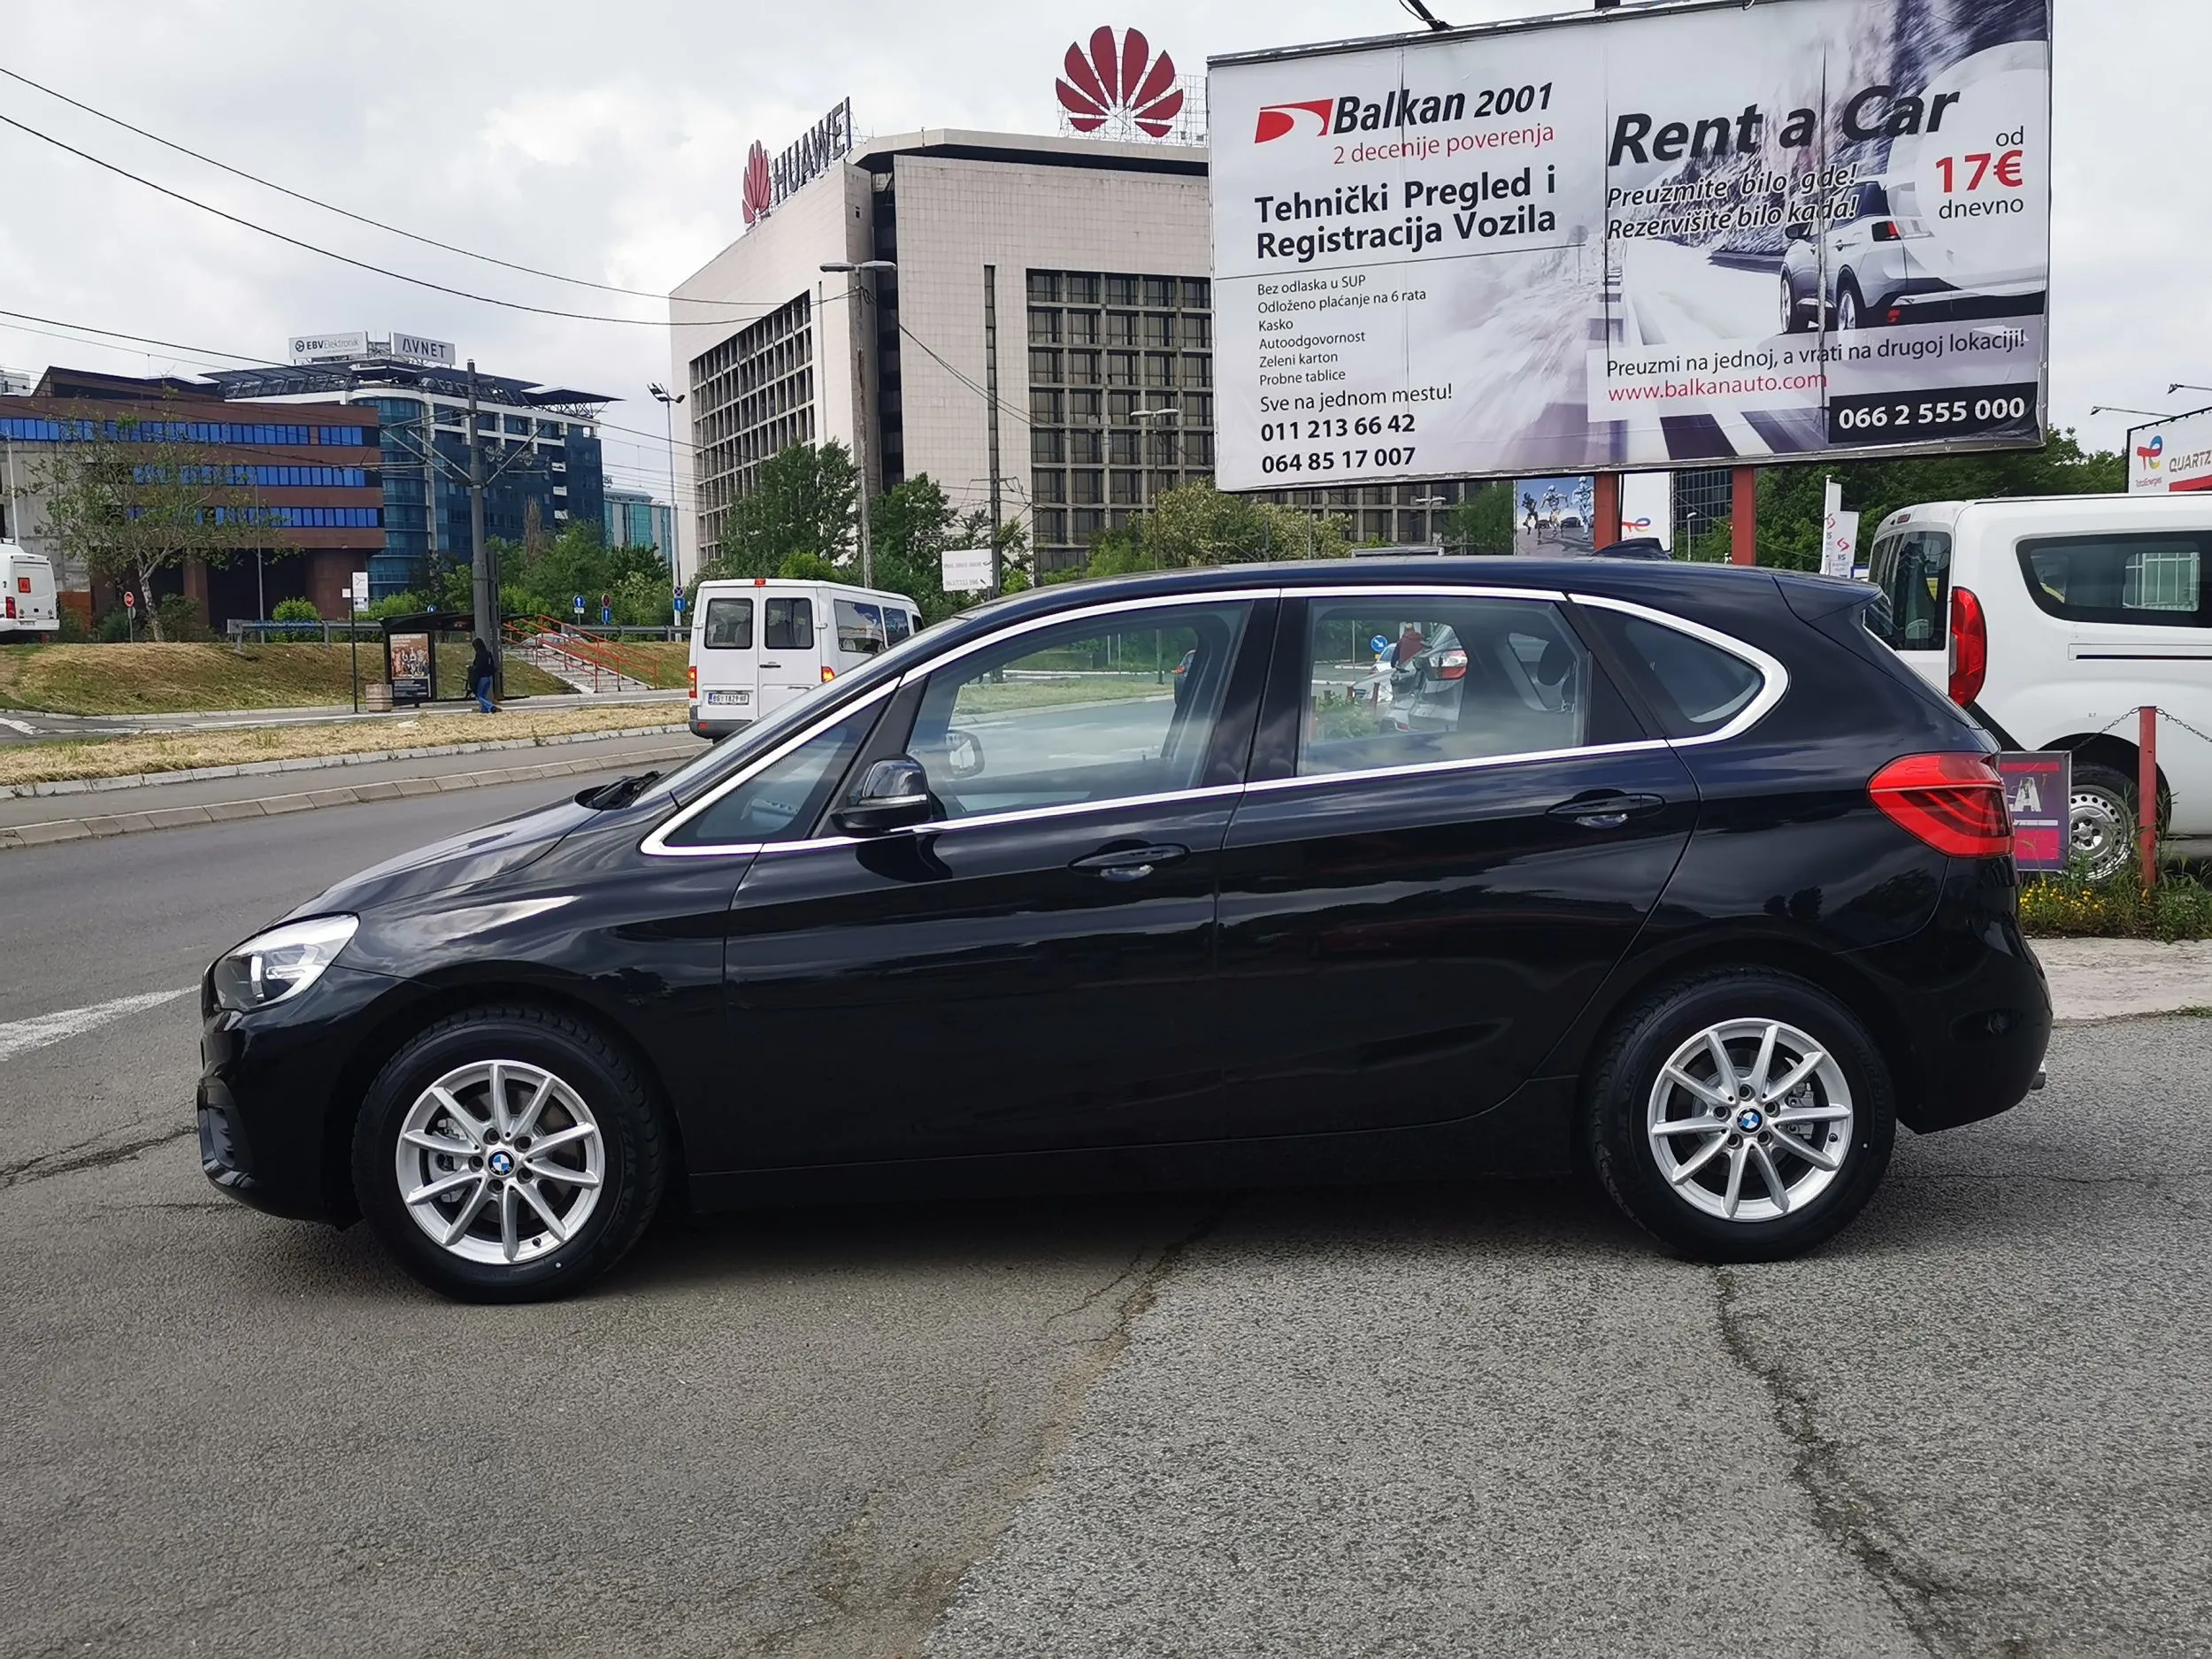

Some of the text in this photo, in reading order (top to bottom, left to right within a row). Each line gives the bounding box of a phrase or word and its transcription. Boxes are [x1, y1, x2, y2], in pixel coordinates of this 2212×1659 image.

[1333, 82, 1553, 134] Balkan 2001
[1607, 85, 1961, 166] Rent a Car
[1996, 125, 2024, 147] od
[774, 96, 851, 205] HUAWEI
[1333, 124, 1554, 165] 2 decenije poverenja
[1935, 149, 2024, 193] 17€
[1255, 165, 1555, 223] Tehnički Pregled i
[1607, 163, 1856, 210] Preuzmite bilo gde!
[1607, 195, 1859, 240] Rezervišite bilo kada!
[1939, 196, 2024, 219] dnevno
[1256, 204, 1555, 263] Registracija Vozila
[1257, 274, 1366, 296] Bez odlaska u SUP
[1257, 288, 1426, 314] Odloženo plaćanje na 6 rata
[1259, 318, 1294, 332] Kasko
[403, 338, 445, 357] AVNET
[1259, 332, 1365, 350] Autoodgovornost
[1607, 331, 2025, 378] Preuzmi na jednoj, a vrati na drugoj lokaciji!
[1259, 351, 1338, 369] Zeleni karton
[1259, 368, 1346, 386] Probne tablice
[1608, 373, 1827, 402] www.balkanauto.com
[1260, 383, 1453, 412] Sve na jednom mestu!
[1838, 397, 2024, 429] 066 2 555 000
[1261, 414, 1415, 442] 011 213 66 42
[1263, 447, 1416, 473] 064 85 17 007
[2170, 450, 2211, 472] QUARTZ
